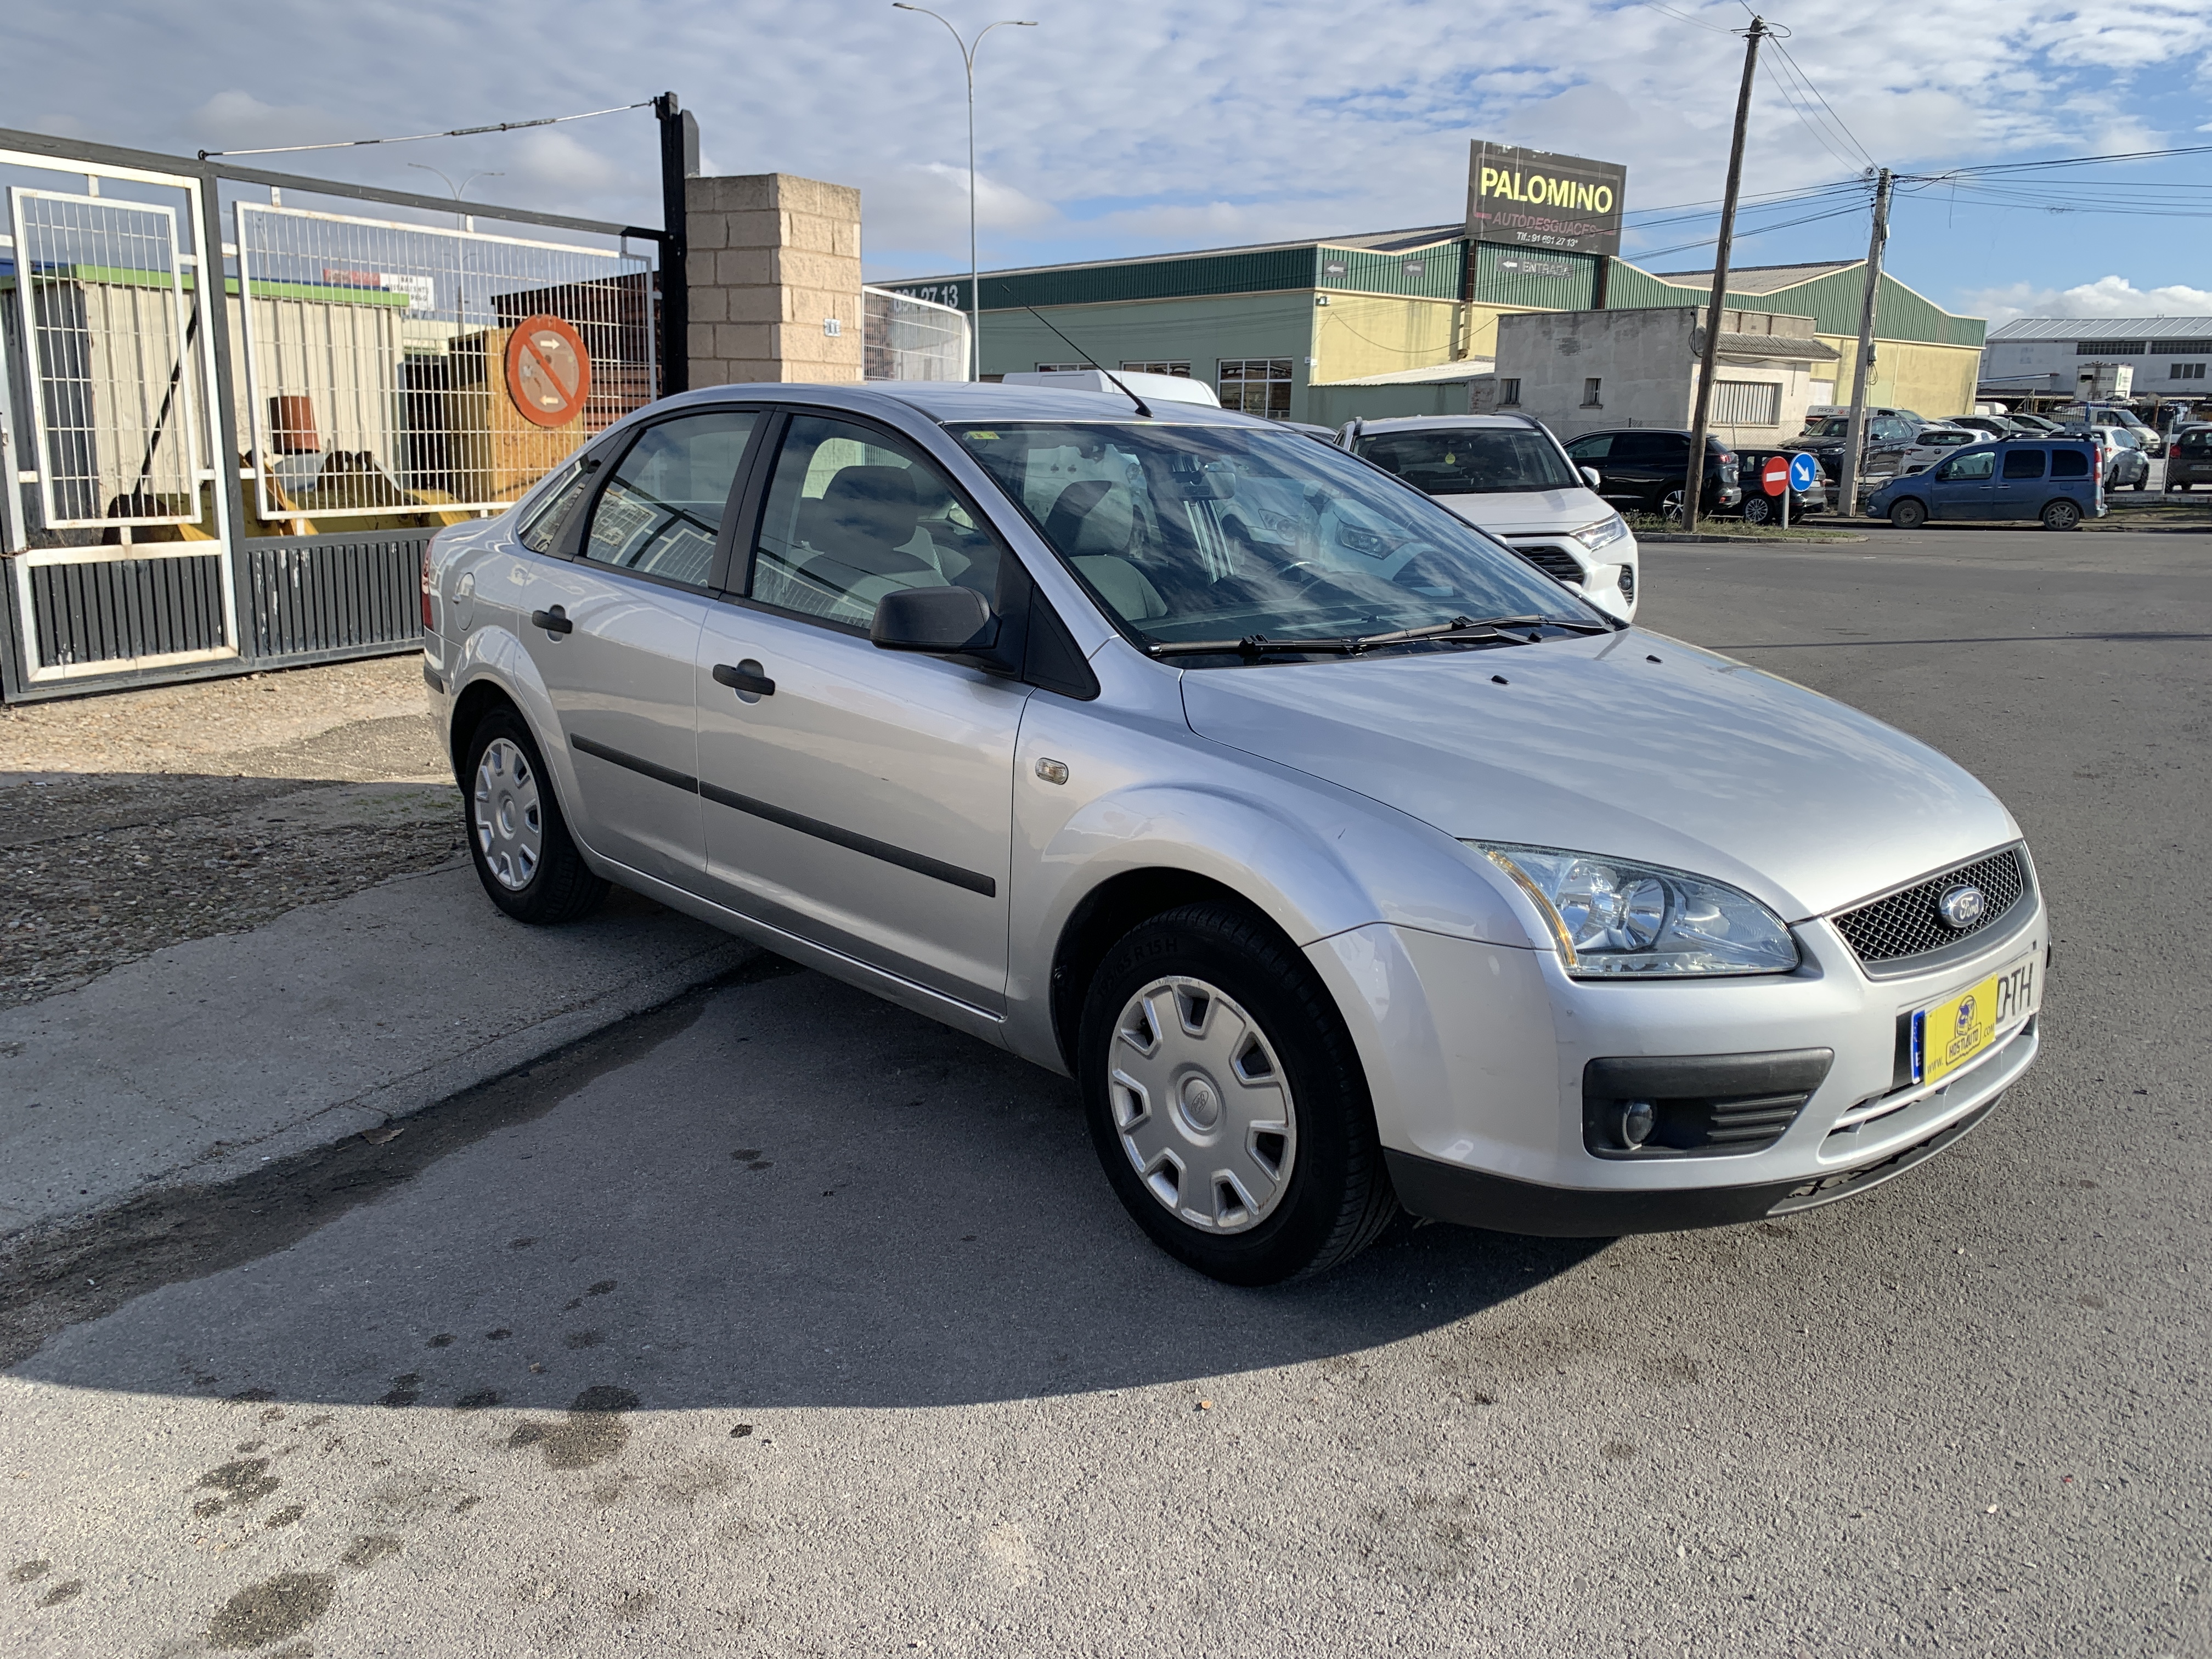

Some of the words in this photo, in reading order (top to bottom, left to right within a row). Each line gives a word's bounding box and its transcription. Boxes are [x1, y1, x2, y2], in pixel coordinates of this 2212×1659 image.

[1481, 167, 1613, 213] PALOMINO
[1492, 211, 1597, 238] AUTODESGUACES
[1532, 234, 1540, 242] 91
[1542, 235, 1555, 244] 691
[1556, 236, 1565, 246] 27
[941, 285, 958, 308] 13
[1959, 895, 1979, 920] Ford
